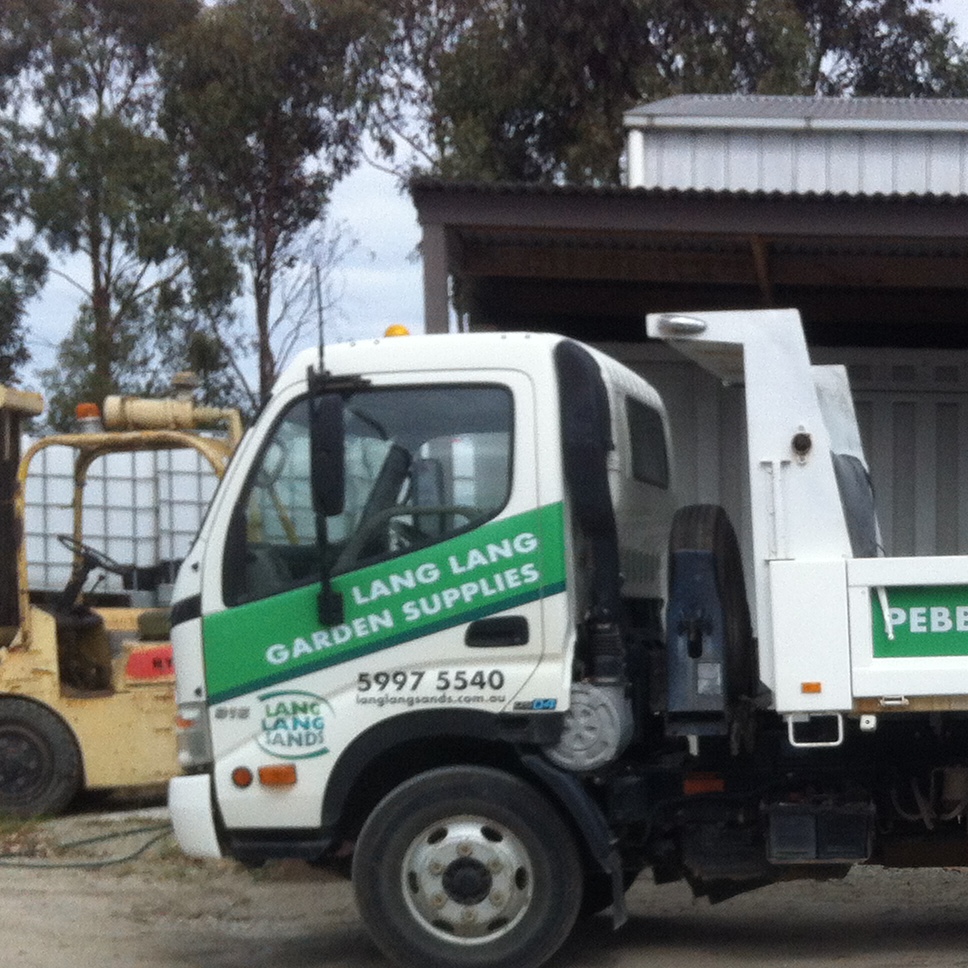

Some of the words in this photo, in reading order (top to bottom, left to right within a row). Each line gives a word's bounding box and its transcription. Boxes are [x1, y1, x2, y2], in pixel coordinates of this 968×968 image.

[352, 562, 441, 605] LANG
[448, 532, 538, 575] LANG
[265, 609, 395, 665] GARDEN
[402, 562, 540, 622] SUPPLIES
[357, 670, 426, 692] 5997
[435, 669, 505, 691] 5540
[265, 701, 320, 718] LANG
[355, 692, 506, 707] langlangsands.com.au
[262, 716, 325, 732] LANG
